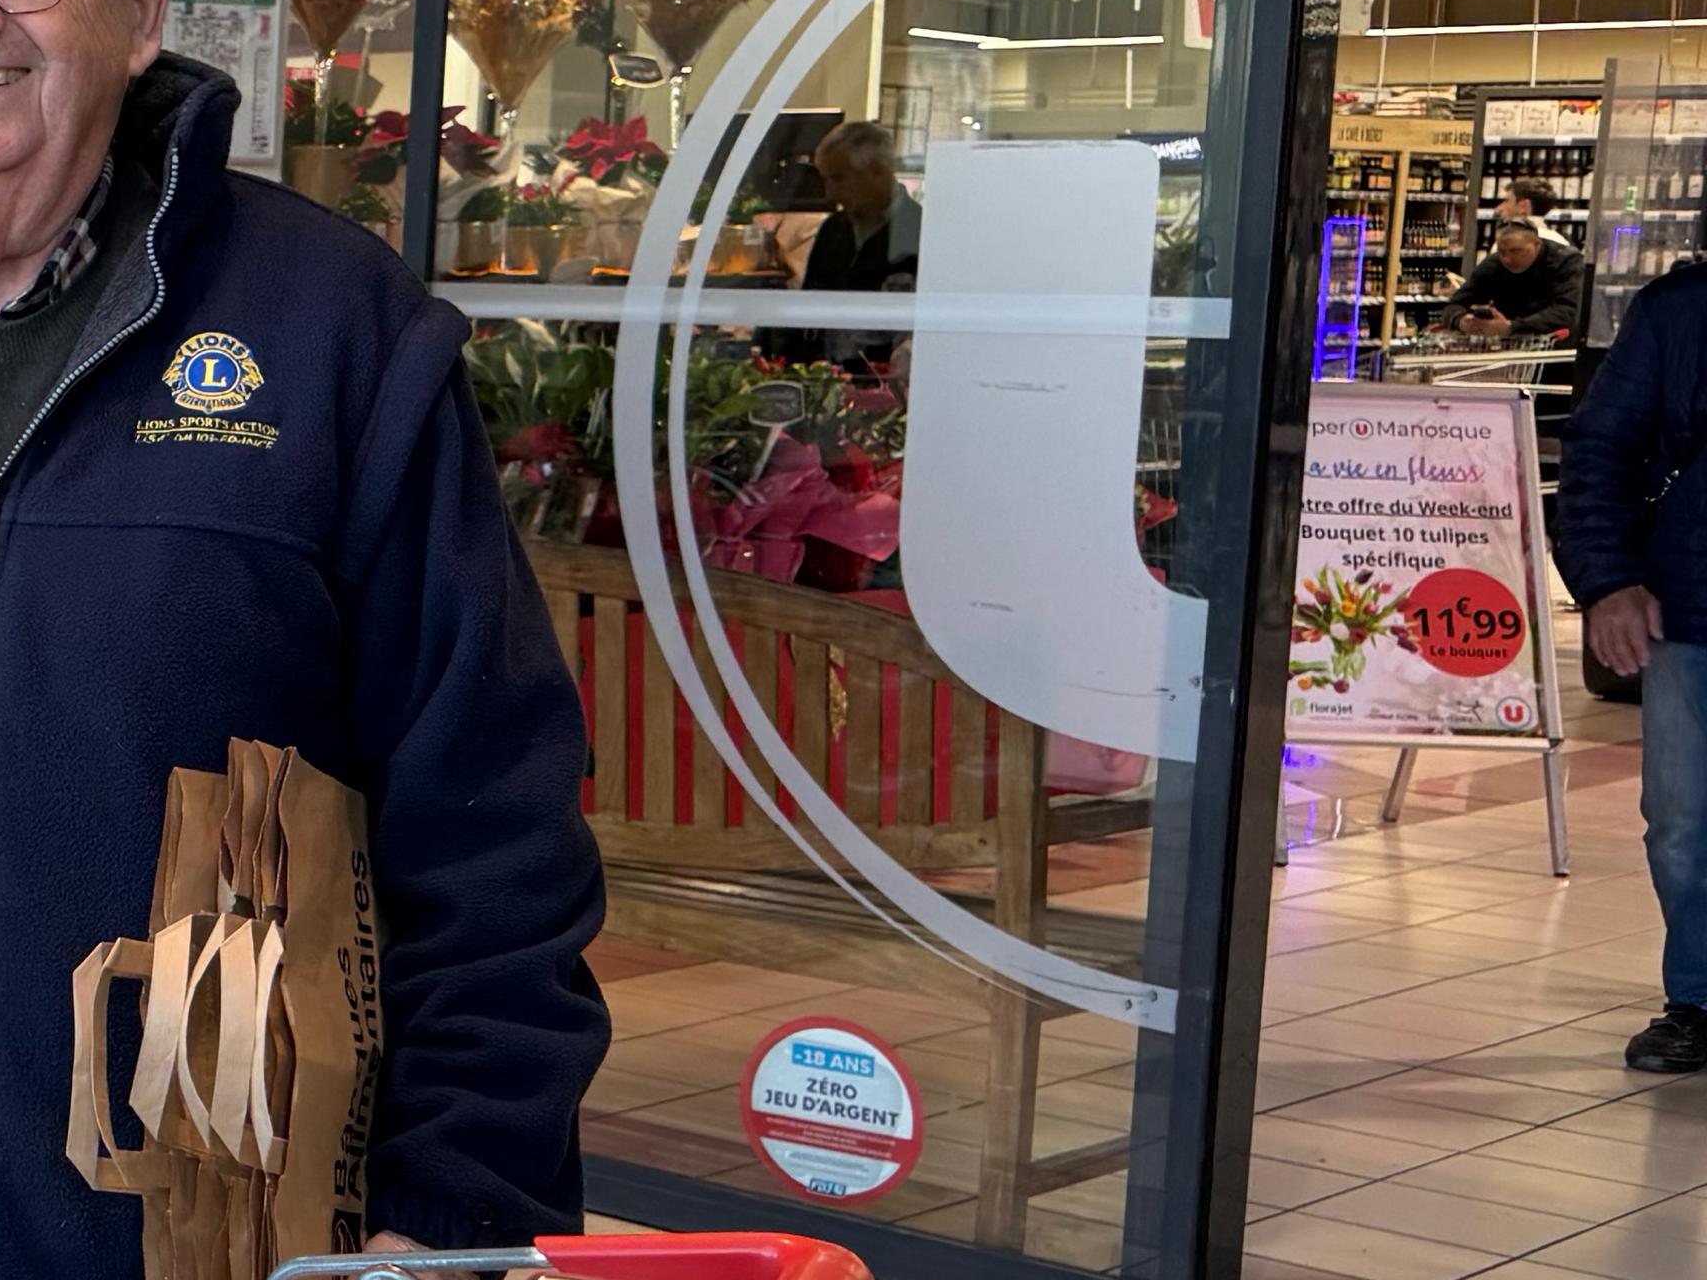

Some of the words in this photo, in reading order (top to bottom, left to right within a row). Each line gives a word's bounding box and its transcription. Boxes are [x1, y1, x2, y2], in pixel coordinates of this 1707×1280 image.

[185, 335, 246, 356] LIONS
[201, 358, 227, 387] L
[137, 419, 175, 431] LIONS
[180, 416, 228, 429] SPORTS
[231, 422, 279, 436] ACTION
[1312, 421, 1346, 438] per
[1377, 421, 1492, 442] Manosque
[1333, 459, 1368, 478] vie
[1376, 463, 1397, 478] en
[1338, 499, 1384, 515] offre
[1389, 500, 1413, 516] du
[1419, 502, 1512, 519] Week-end
[1301, 524, 1390, 543] Bouquet
[1394, 527, 1414, 543] 10
[1420, 527, 1490, 548] tulipes
[1342, 551, 1446, 570] spécifique
[1449, 645, 1508, 659] bouquet
[1502, 704, 1524, 723] U
[794, 1049, 826, 1064] -18
[829, 1055, 872, 1074] ANS
[806, 1075, 857, 1100] ZÉRO
[764, 1089, 798, 1108] JEU
[802, 1096, 899, 1128] D'ARGENT
